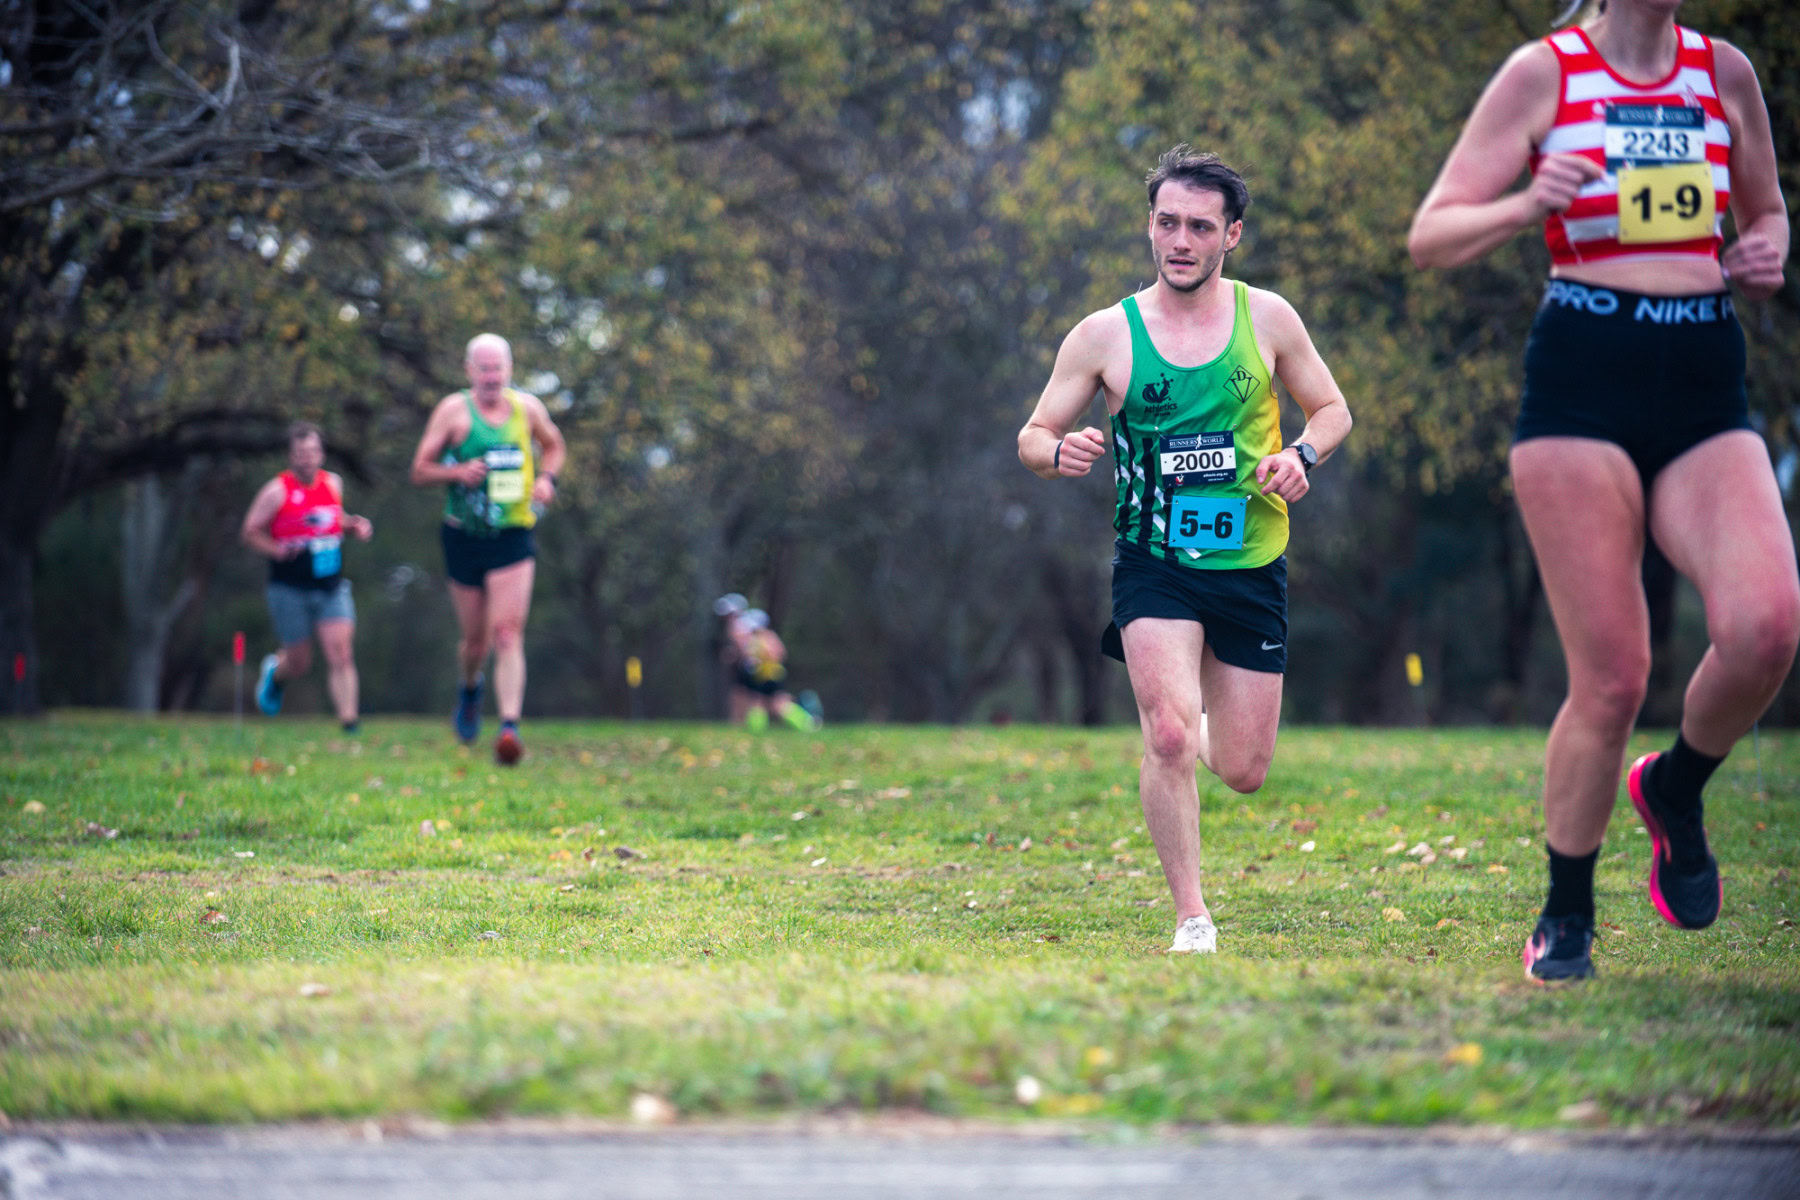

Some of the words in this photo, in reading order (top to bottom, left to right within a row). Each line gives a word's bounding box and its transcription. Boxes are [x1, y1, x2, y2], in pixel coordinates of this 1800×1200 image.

[1623, 129, 1689, 157] 2243
[1631, 184, 1702, 221] 1-9
[1634, 296, 1717, 324] NIKE
[1144, 403, 1177, 413] Athletics
[1169, 439, 1197, 447] RUNNERS
[1173, 451, 1224, 472] 2000
[1179, 510, 1233, 538] 5-6
